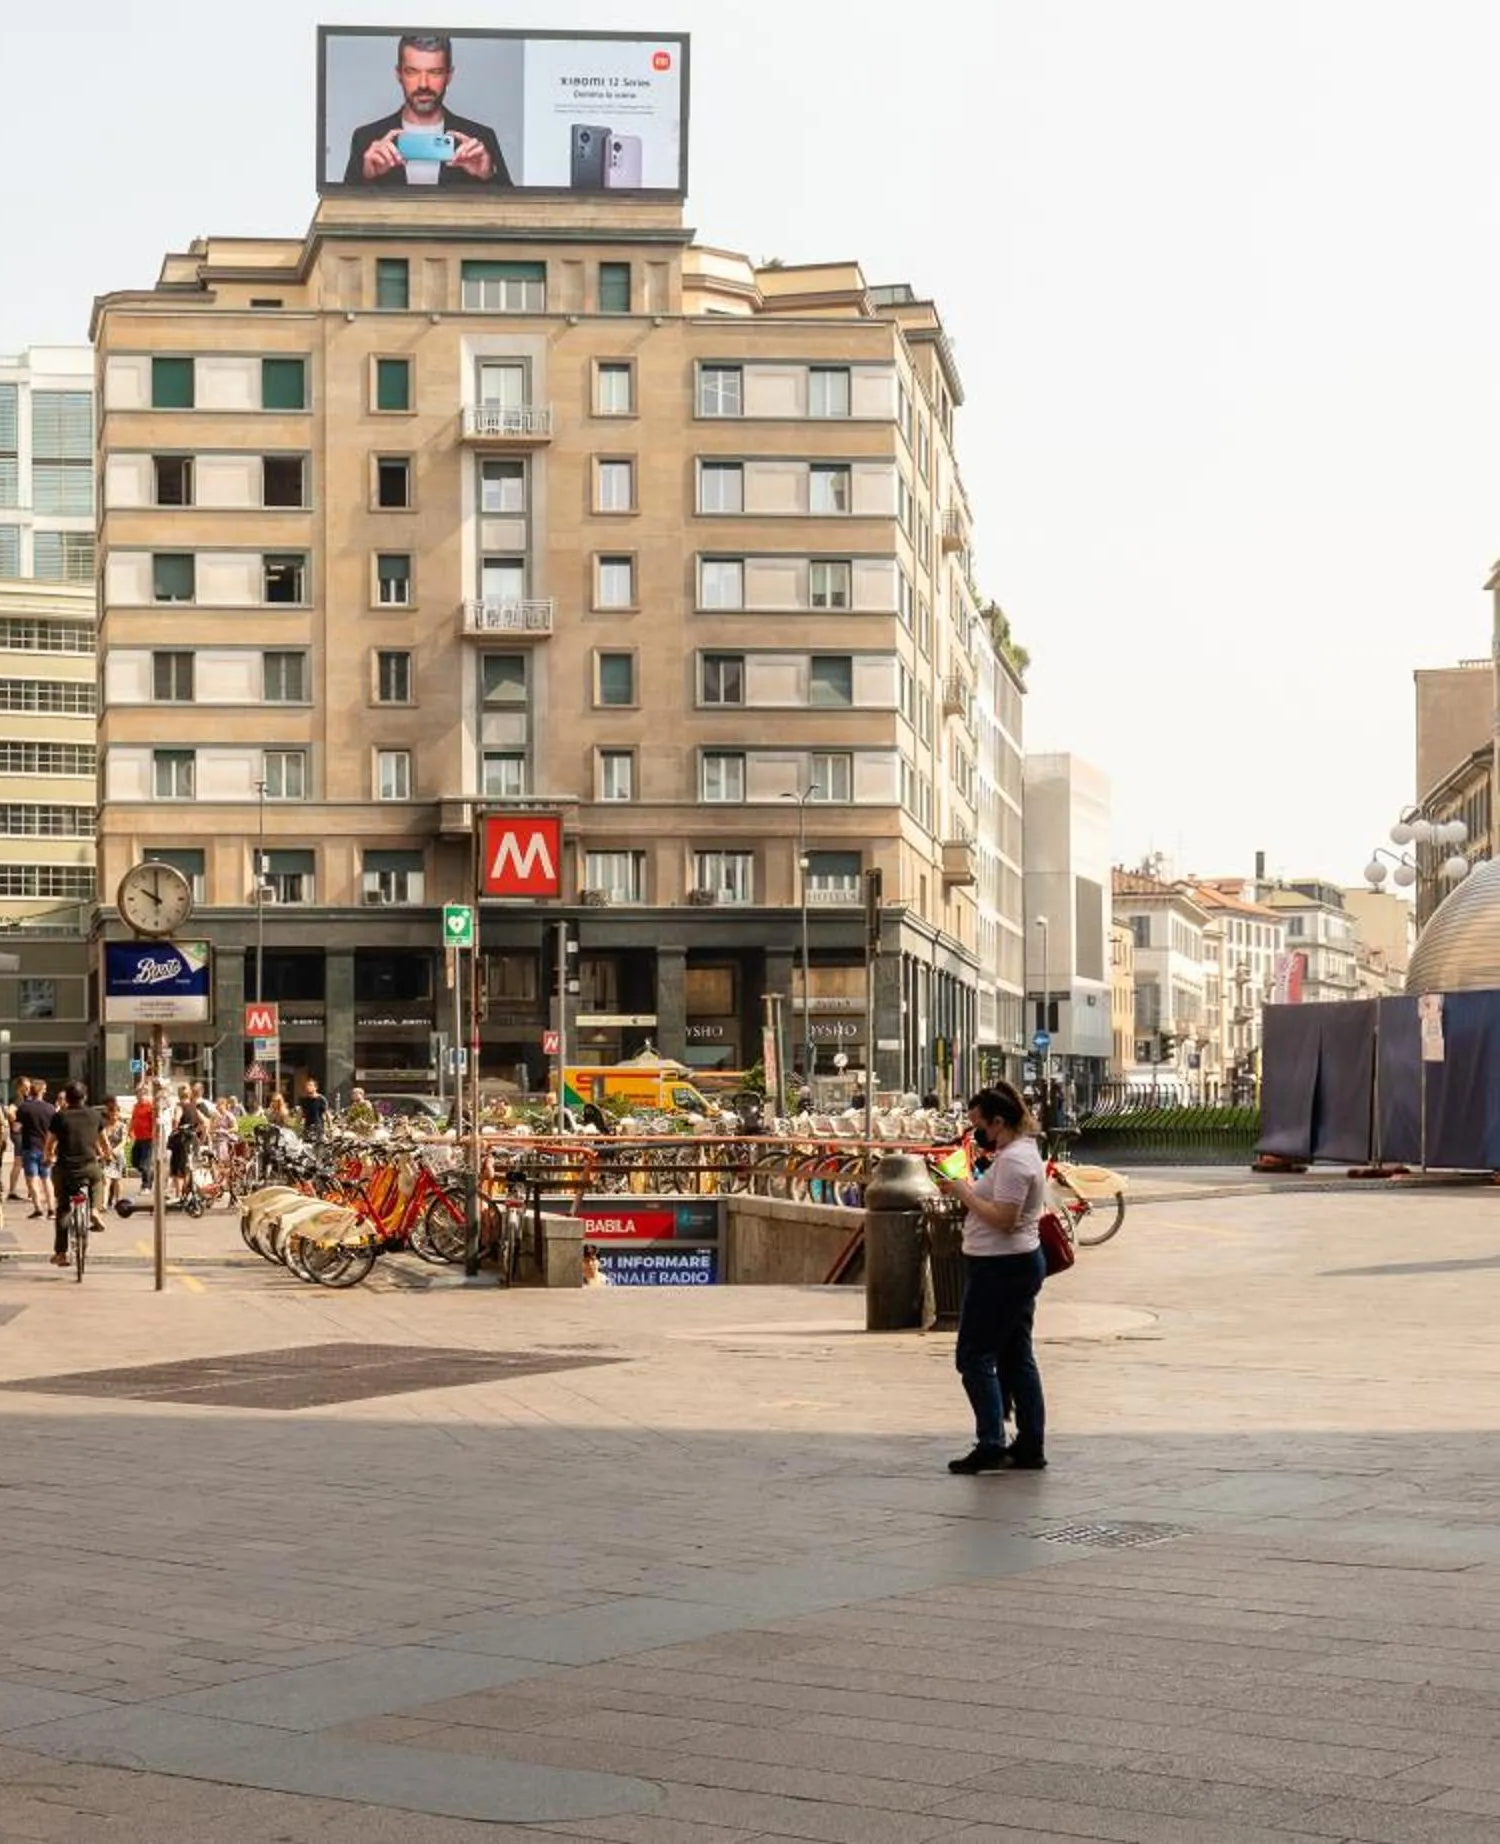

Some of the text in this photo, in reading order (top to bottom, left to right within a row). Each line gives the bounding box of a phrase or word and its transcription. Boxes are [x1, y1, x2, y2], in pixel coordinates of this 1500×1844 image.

[491, 831, 556, 879] M
[131, 957, 182, 985] Boots
[248, 1010, 273, 1030] M
[585, 1219, 636, 1233] BABILA
[617, 1255, 711, 1269] INFORMARE
[659, 1271, 709, 1284] RADIO
